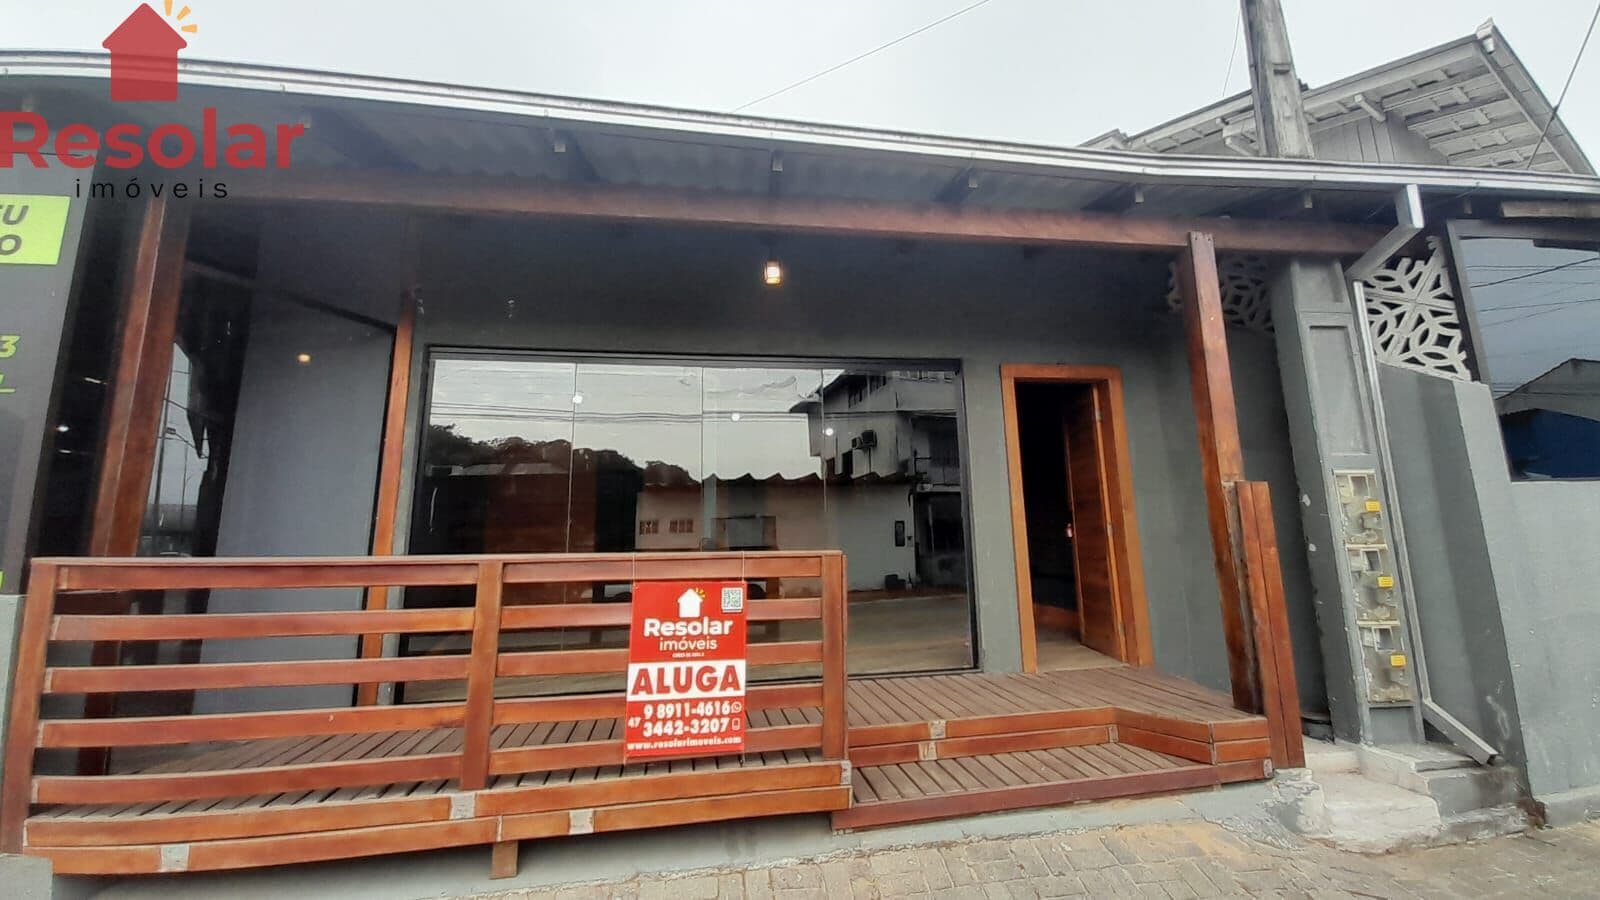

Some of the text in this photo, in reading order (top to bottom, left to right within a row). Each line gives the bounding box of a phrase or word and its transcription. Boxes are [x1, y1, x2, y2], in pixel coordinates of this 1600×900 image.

[0, 204, 30, 225] U
[644, 617, 733, 636] Resolar
[659, 637, 717, 651] imóveis
[631, 665, 741, 695] ALUGA
[644, 702, 730, 719] 9 8911-4616
[628, 718, 640, 728] 47
[643, 718, 729, 736] 3442-3207
[627, 737, 741, 750] www.resolarimoveis.com
